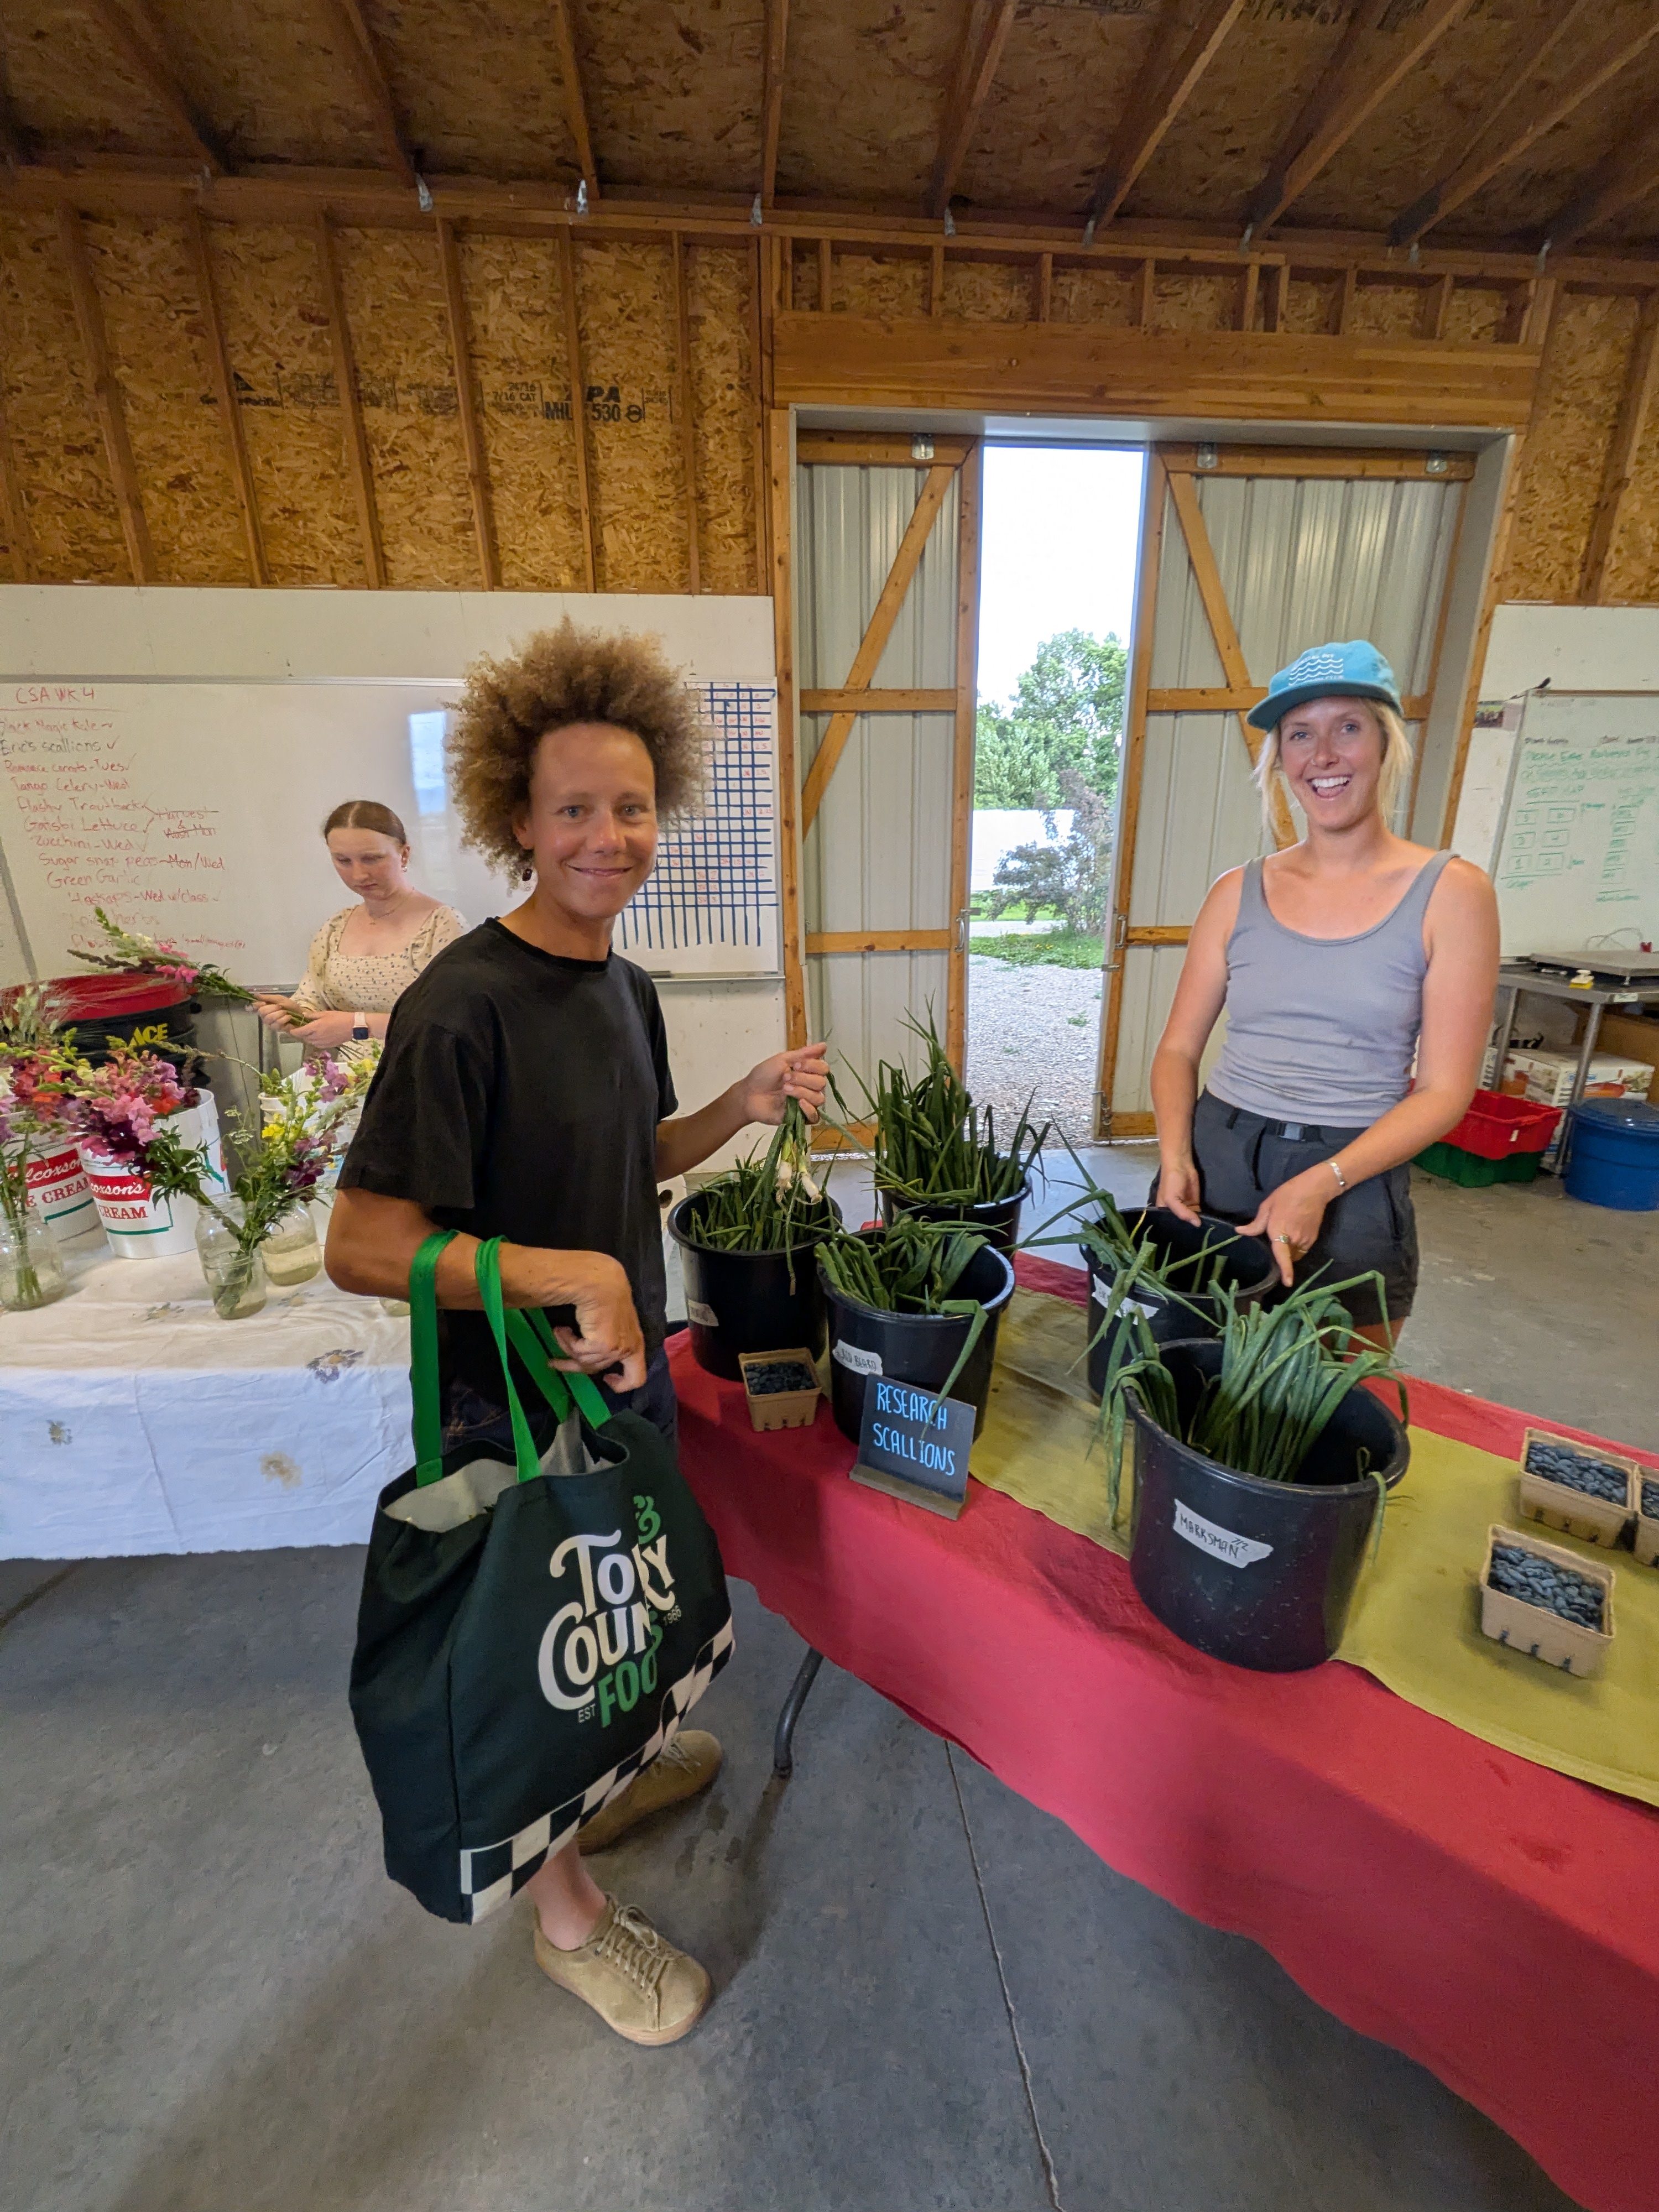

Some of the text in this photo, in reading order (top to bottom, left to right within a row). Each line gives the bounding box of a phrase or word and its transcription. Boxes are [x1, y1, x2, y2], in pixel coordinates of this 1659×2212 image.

[519, 393, 536, 402] CAT
[592, 404, 621, 422] 530
[16, 686, 50, 704] CSA
[83, 687, 95, 700] 4
[41, 738, 101, 753] scallions
[47, 872, 92, 888] Green
[877, 1383, 947, 1430] RESEARCH
[873, 1422, 956, 1476] SCALLIONS
[1180, 1512, 1239, 1559] MARKSMAN
[578, 1704, 596, 1724] EST
